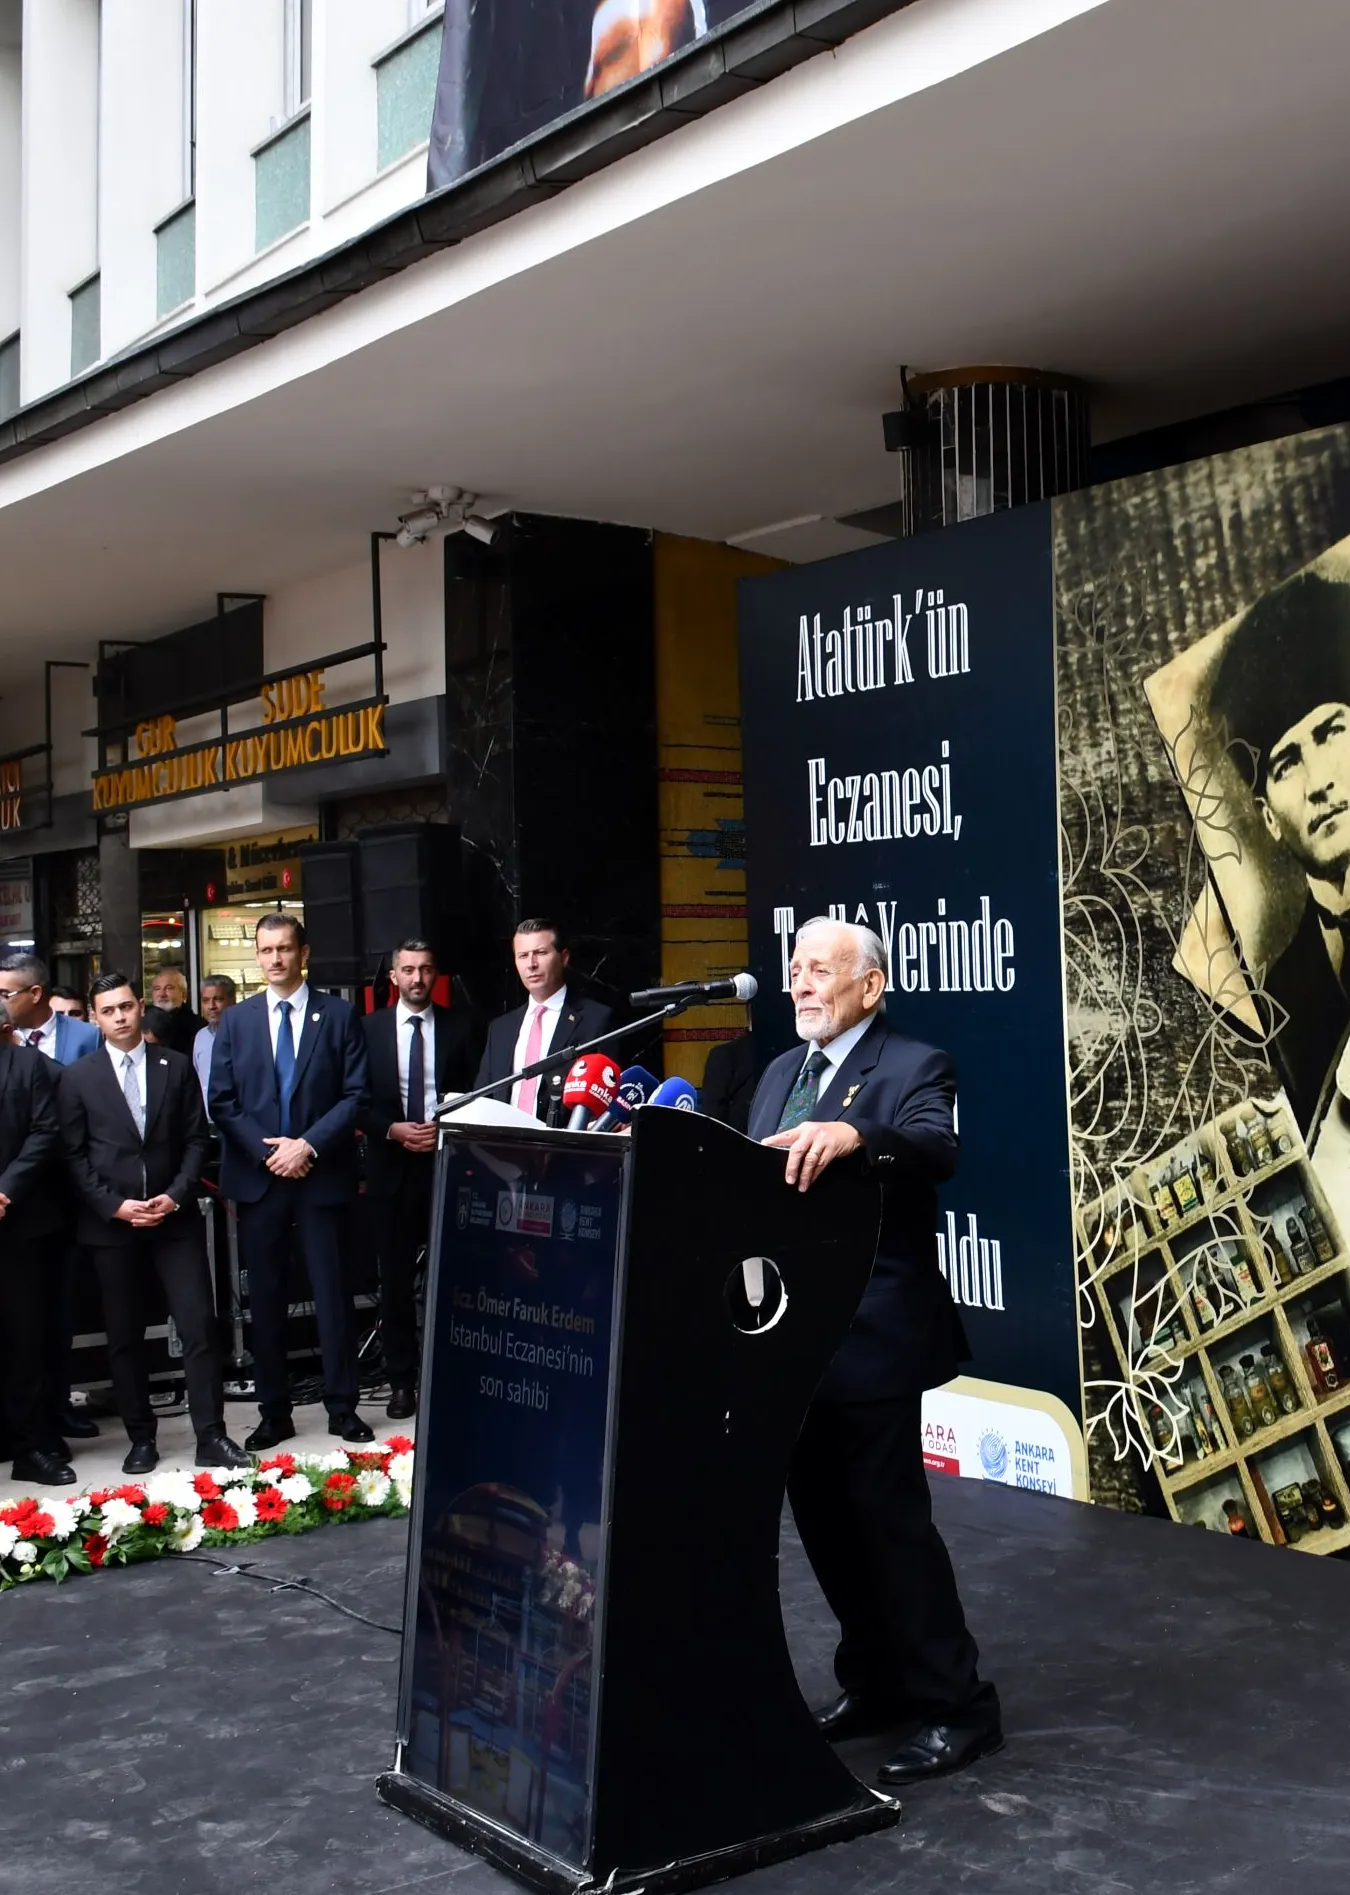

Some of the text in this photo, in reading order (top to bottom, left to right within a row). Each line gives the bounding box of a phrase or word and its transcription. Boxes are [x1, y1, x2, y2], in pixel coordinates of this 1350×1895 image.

[260, 669, 325, 723] SUDE
[225, 704, 385, 781] KUYUMCULUK
[92, 748, 219, 811] KUYUMCULUK
[808, 740, 962, 846] Eczanesi,
[876, 897, 1016, 992] Yerinde
[590, 1083, 613, 1104] anka
[476, 1284, 511, 1318] Ömer
[512, 1297, 549, 1325] Faruk
[551, 1305, 595, 1335] Erdem
[449, 1315, 593, 1377] İstanbul Eczanesi'nin
[479, 1375, 550, 1411] son sahibi
[924, 1423, 957, 1444] ARA
[928, 1440, 957, 1455] ODASI
[1015, 1441, 1055, 1462] ANKARA
[1015, 1457, 1040, 1475] KENT
[1015, 1474, 1057, 1496] KONSEYİ
